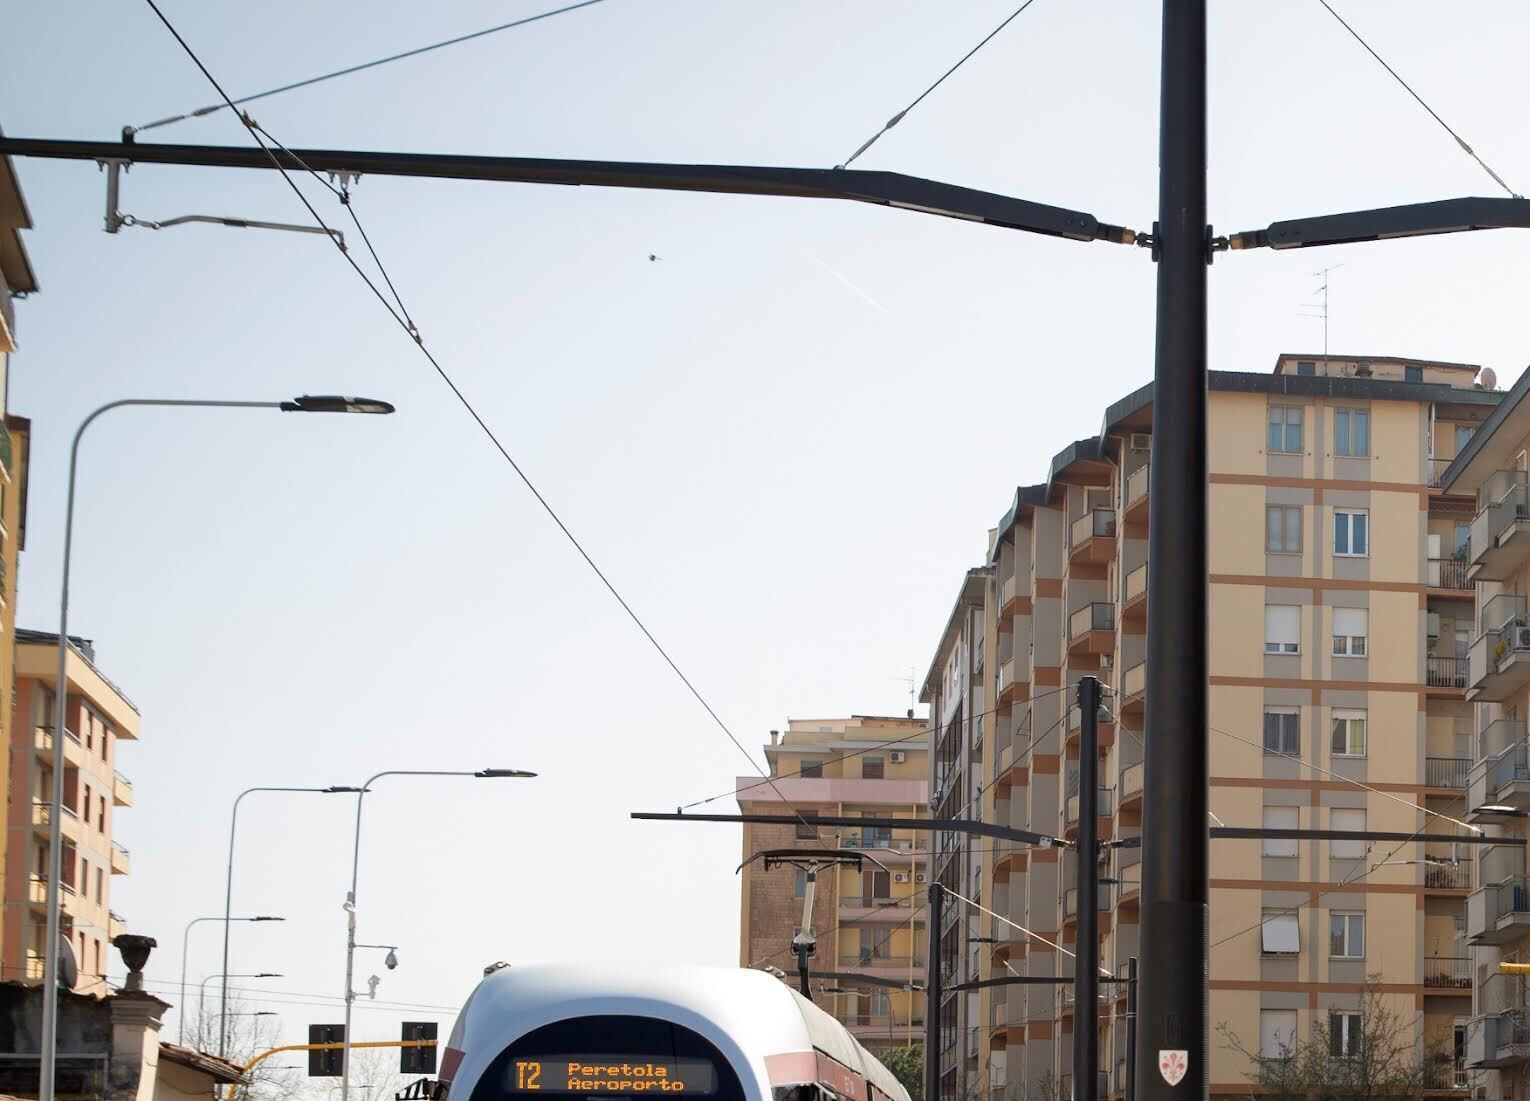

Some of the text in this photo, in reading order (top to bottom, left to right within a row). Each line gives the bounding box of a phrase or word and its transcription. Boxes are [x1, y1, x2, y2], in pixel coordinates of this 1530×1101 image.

[516, 1062, 541, 1090] T2
[567, 1062, 667, 1077] Peretola
[567, 1077, 685, 1091] Aeroporto
